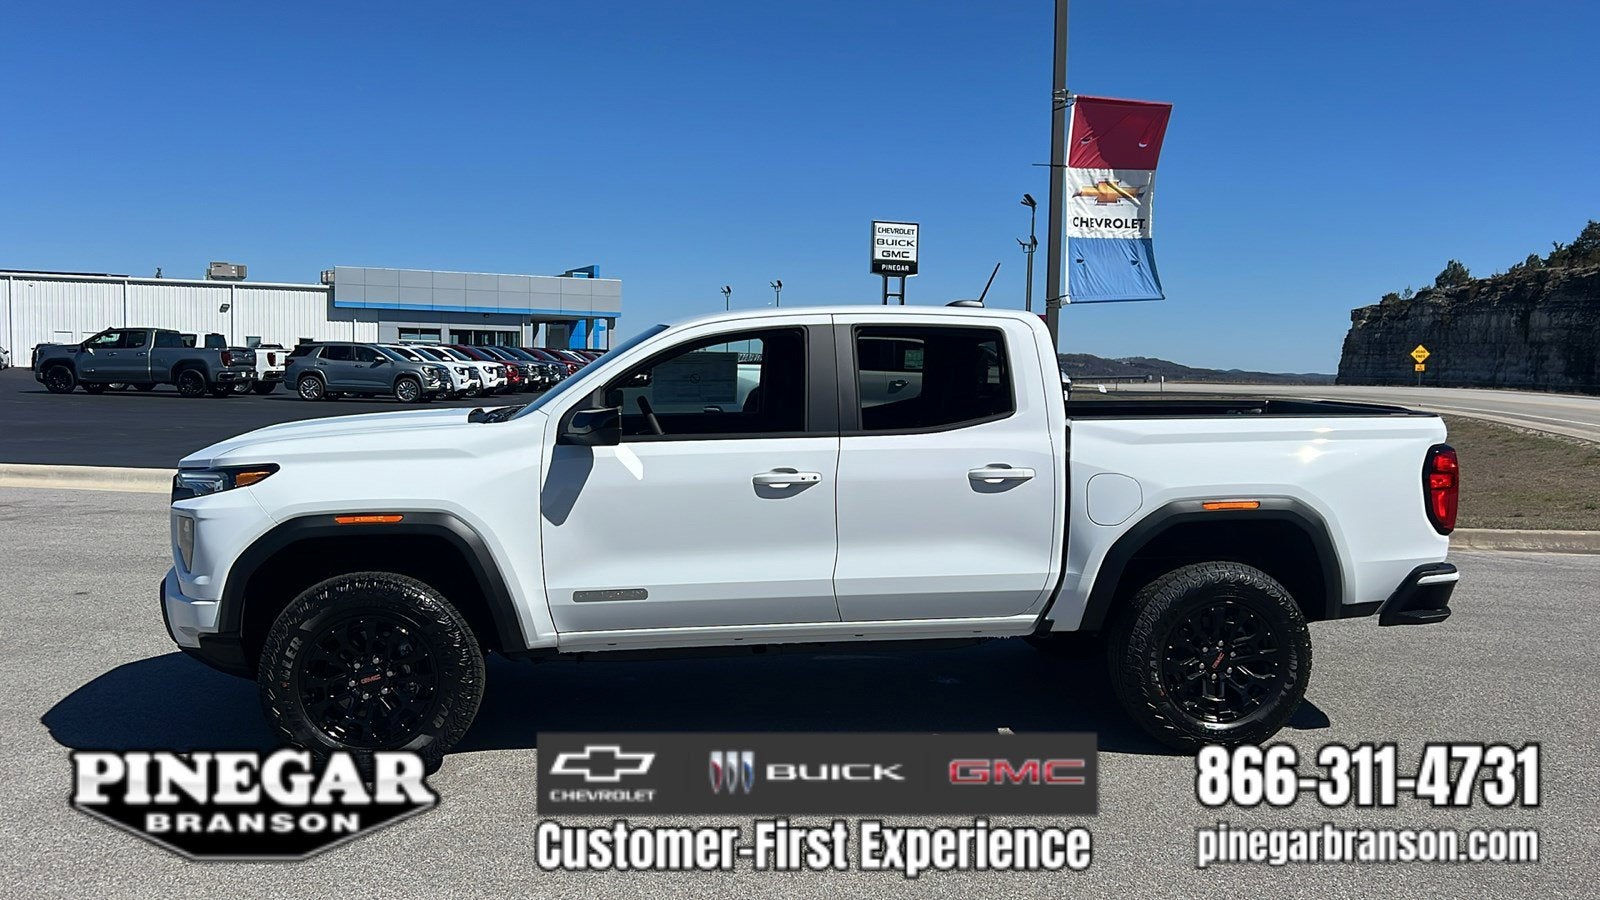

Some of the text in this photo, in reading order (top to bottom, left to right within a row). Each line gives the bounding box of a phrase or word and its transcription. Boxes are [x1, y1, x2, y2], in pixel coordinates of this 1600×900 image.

[1073, 217, 1145, 229] CHEVROLET
[877, 227, 915, 235] CHEVROLET
[877, 239, 915, 247] BUICK
